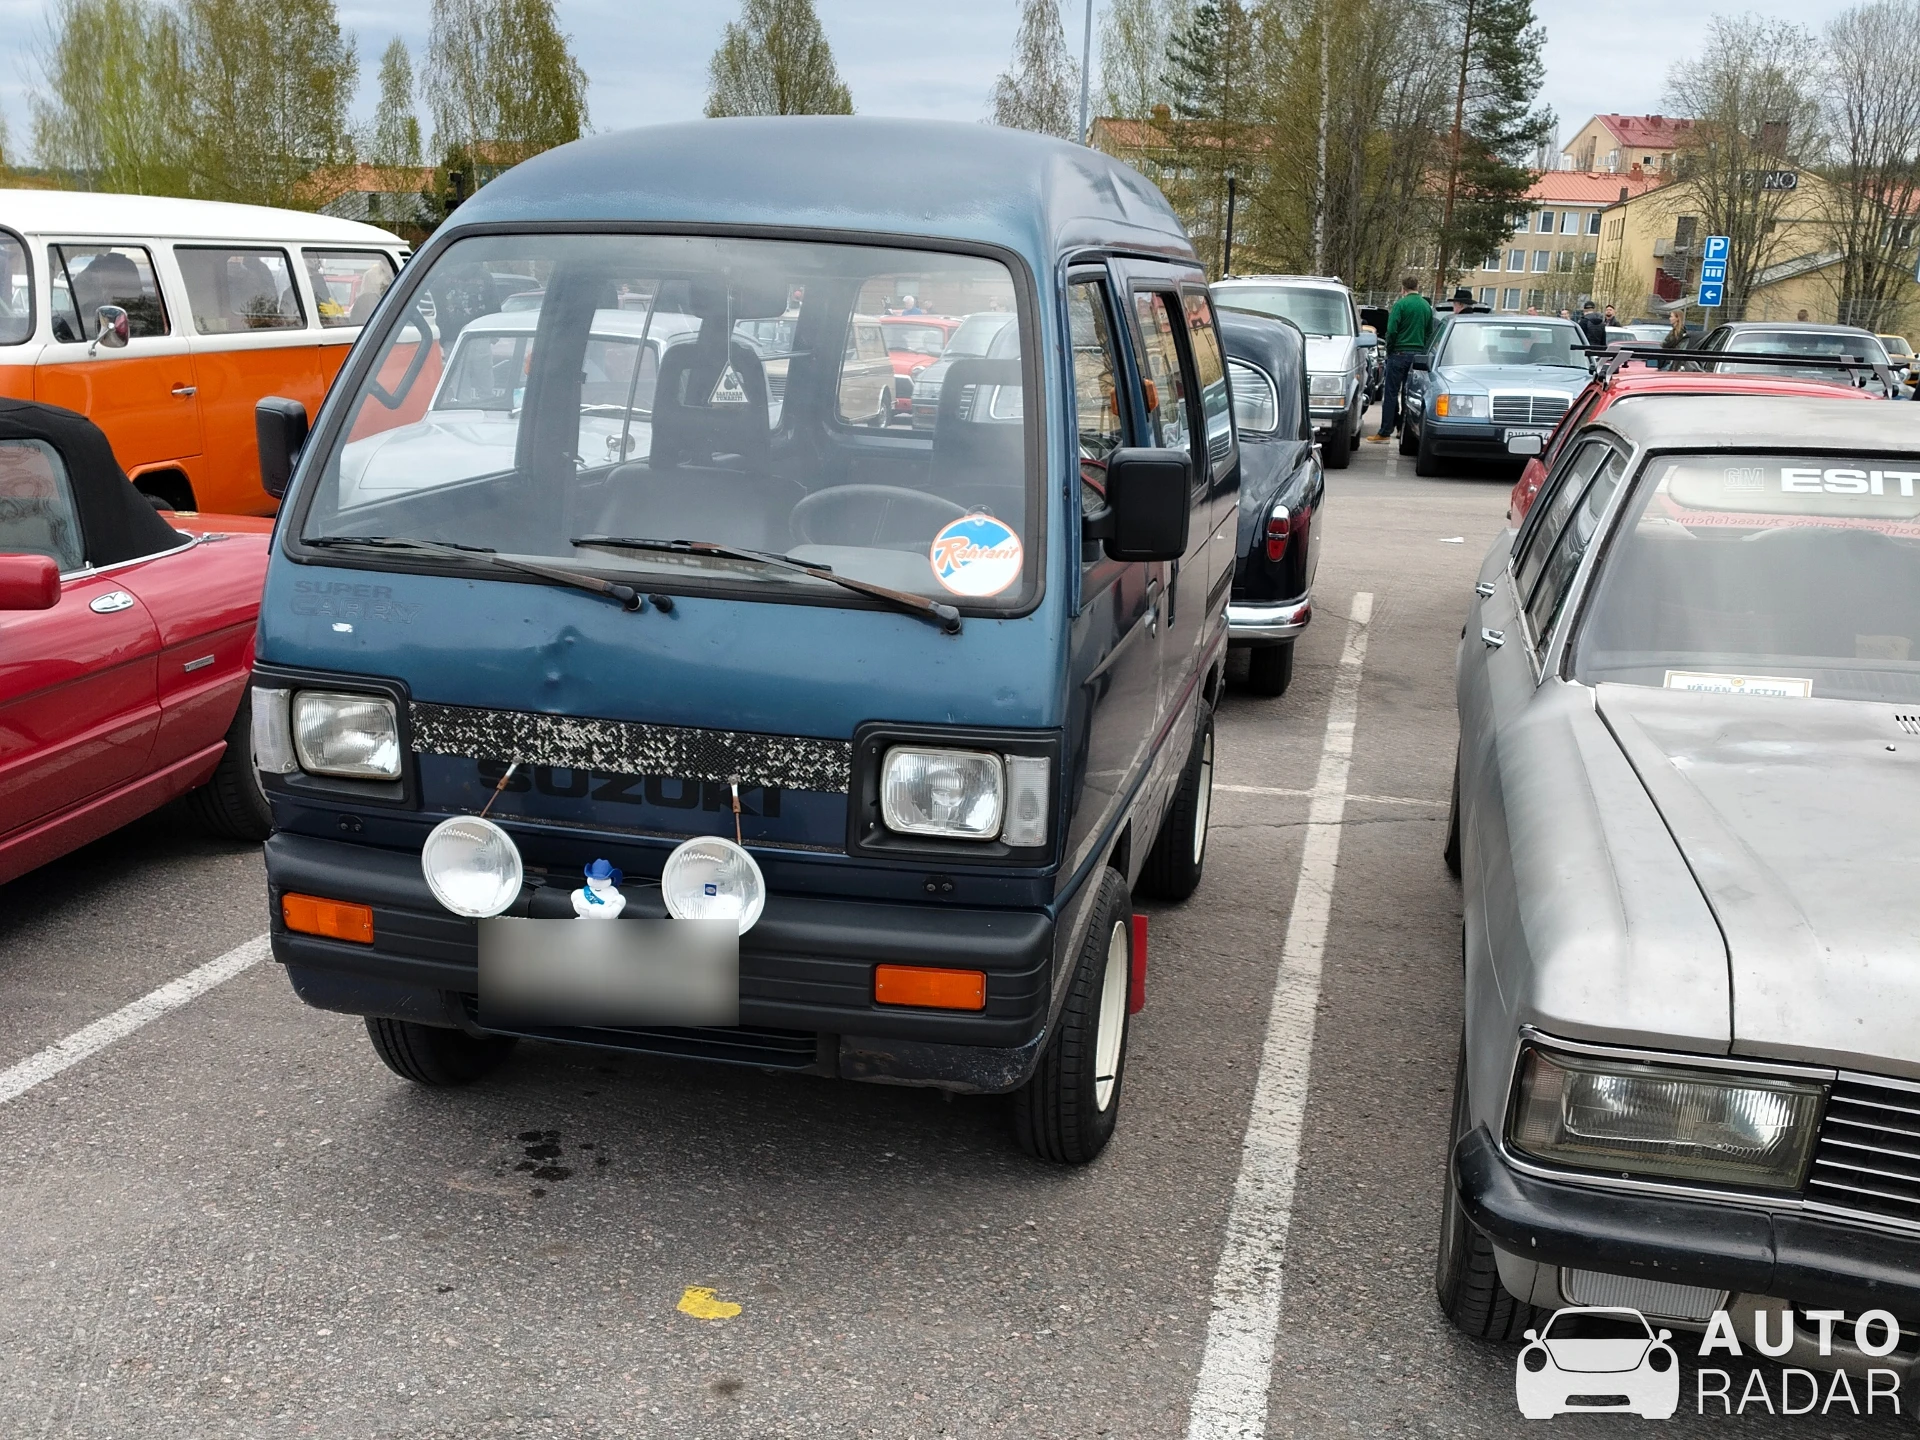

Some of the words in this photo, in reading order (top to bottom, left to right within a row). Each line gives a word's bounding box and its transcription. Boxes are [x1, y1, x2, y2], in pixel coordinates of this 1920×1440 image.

[1708, 238, 1725, 258] P
[1724, 467, 1765, 487] GM
[1781, 467, 1920, 497] ESIT
[936, 536, 1020, 570] Rahtarit
[294, 580, 393, 599] SUPER
[289, 595, 423, 625] CARRY
[477, 759, 781, 818] SUZUKI
